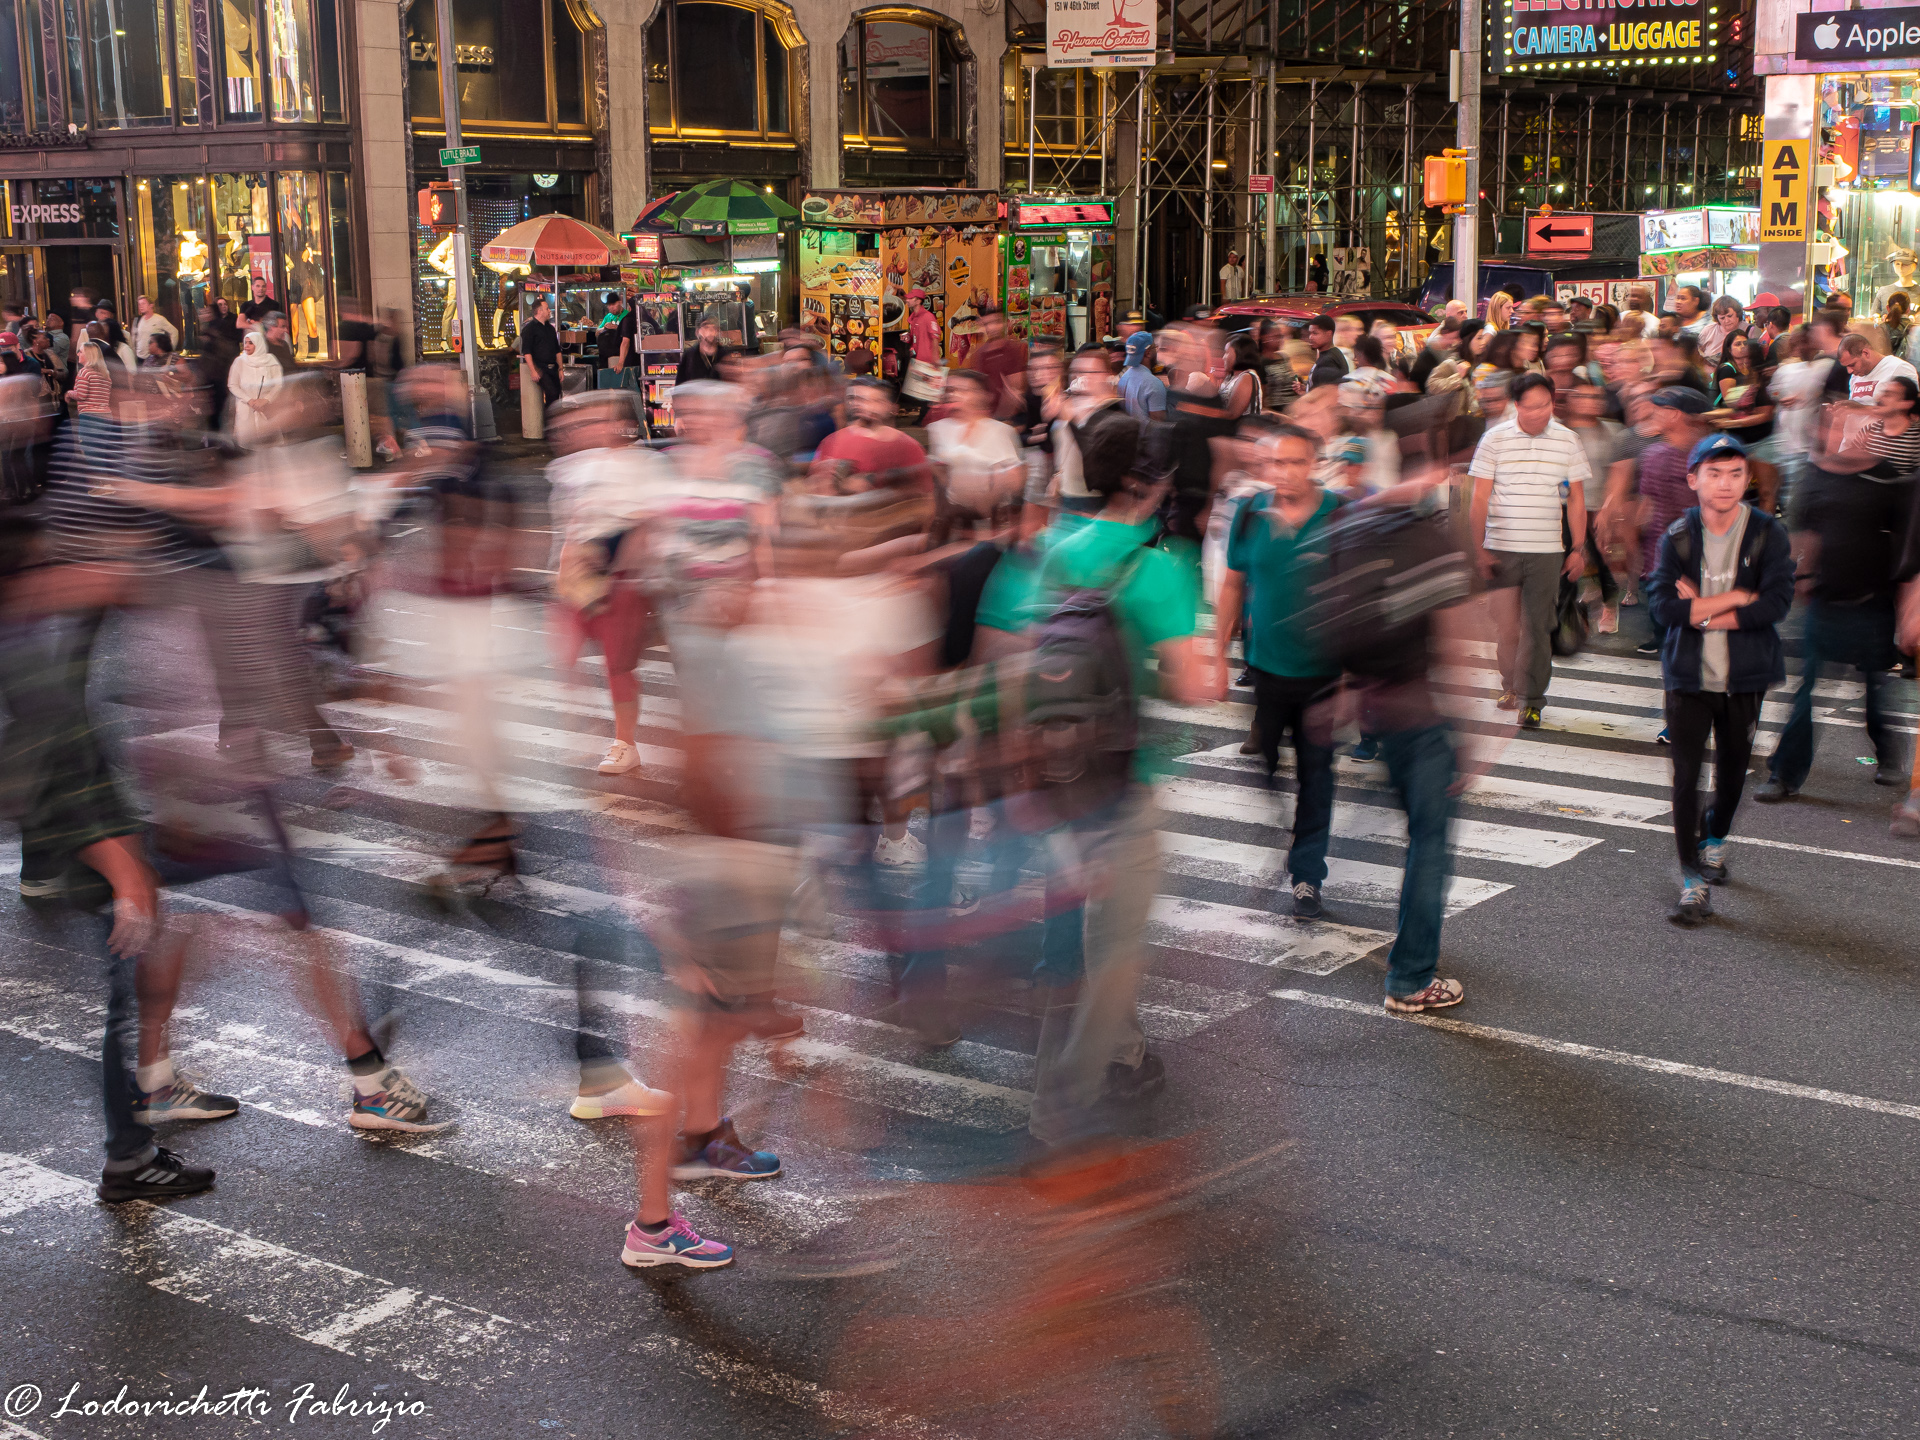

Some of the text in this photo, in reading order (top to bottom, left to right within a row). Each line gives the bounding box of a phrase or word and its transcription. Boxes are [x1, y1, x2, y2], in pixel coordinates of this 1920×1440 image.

[1054, 0, 1100, 11] 151 W 46th Street
[1053, 28, 1150, 53] Havana Central
[1513, 20, 1701, 55] CAMERA LUGGAGE
[1845, 21, 1920, 52] Apple
[410, 41, 495, 65] EXESS
[443, 148, 478, 160] LITTLE BRAZIL
[1770, 146, 1800, 227] ATM
[11, 203, 80, 224] EXPRESS
[1764, 229, 1802, 237] INSIDE
[1582, 287, 1603, 306] $5
